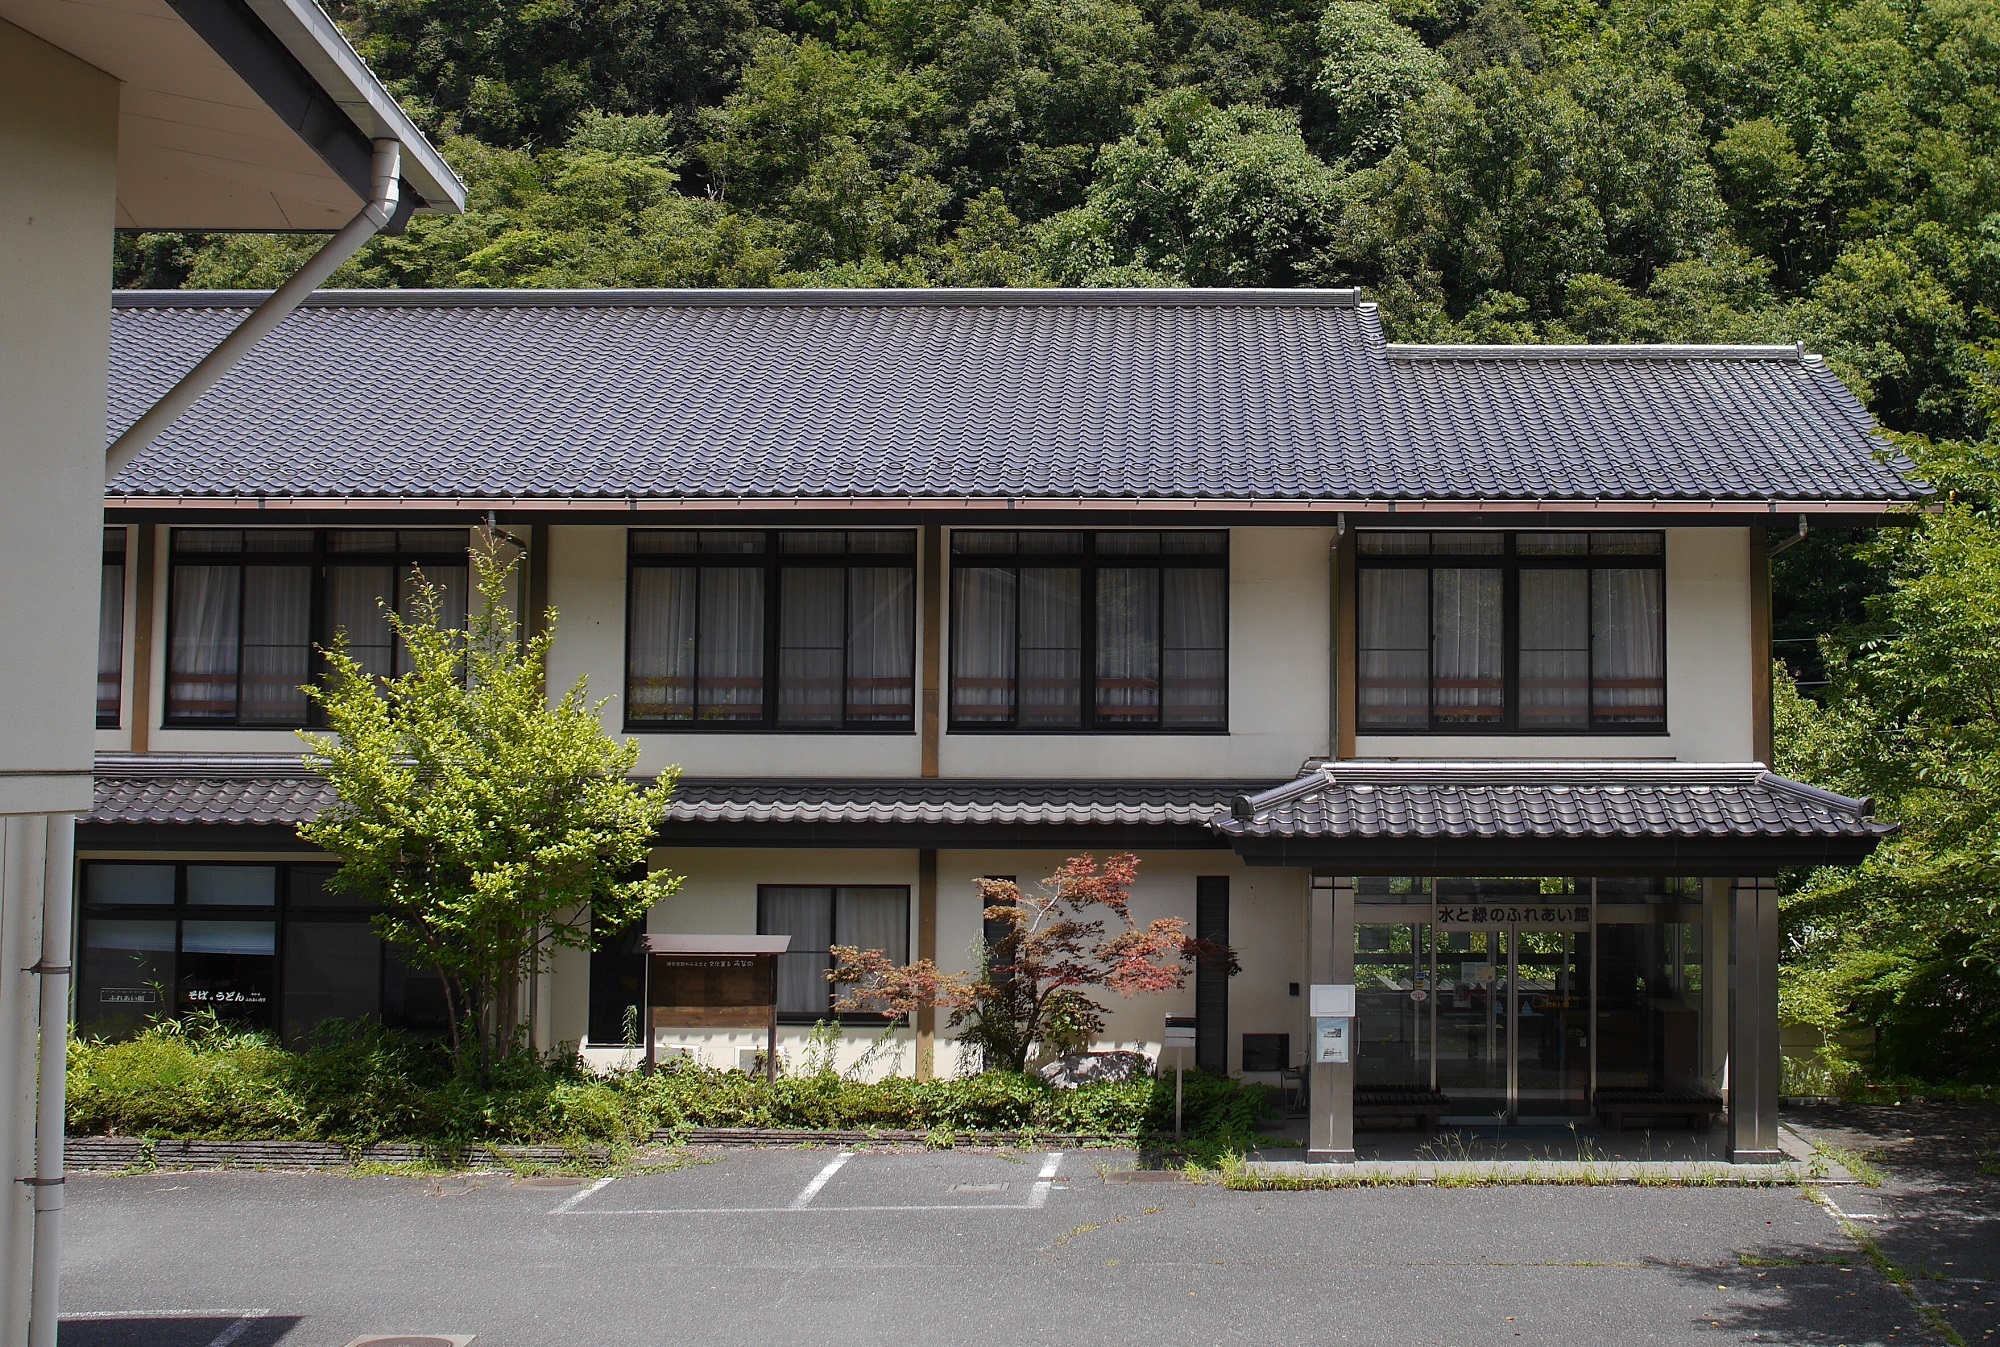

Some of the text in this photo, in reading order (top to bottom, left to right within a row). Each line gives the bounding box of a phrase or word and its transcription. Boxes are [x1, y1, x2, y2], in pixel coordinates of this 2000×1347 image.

[1438, 907, 1590, 923] 水と緑のふれあい館
